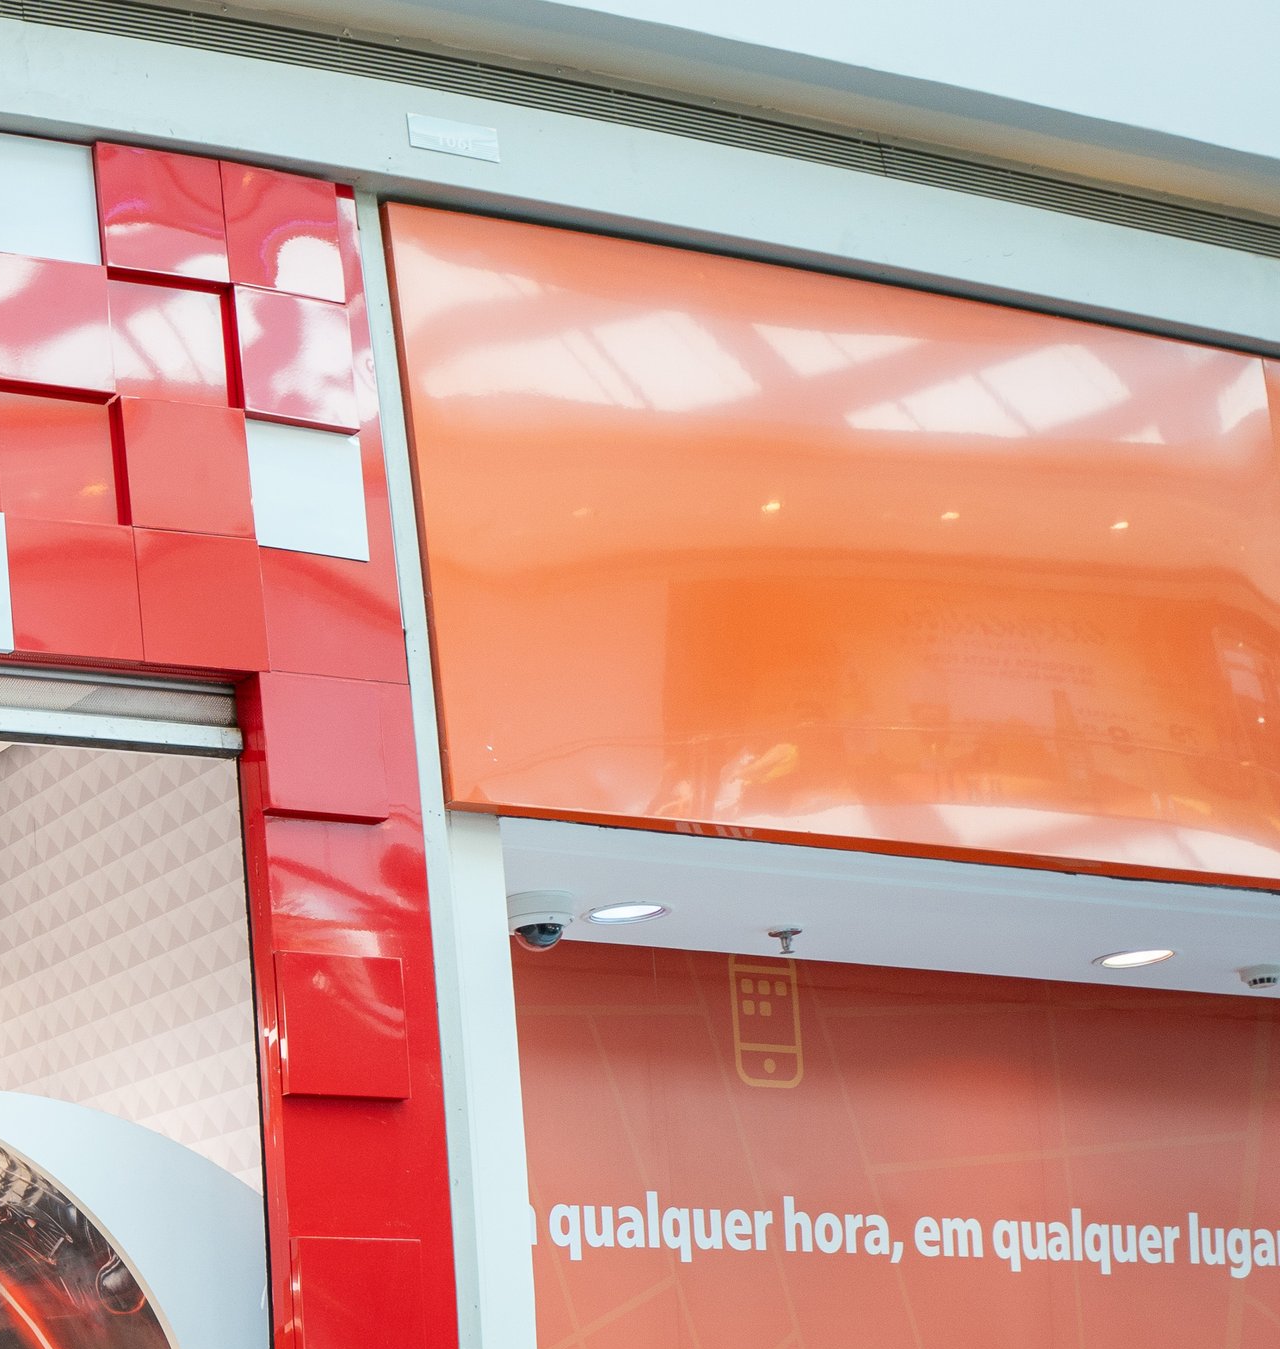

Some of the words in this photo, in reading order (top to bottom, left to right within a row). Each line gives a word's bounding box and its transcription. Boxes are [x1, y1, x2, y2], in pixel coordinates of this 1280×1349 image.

[548, 1190, 774, 1263] qualquer
[783, 1195, 904, 1264] hora,
[914, 1215, 984, 1258] em
[992, 1207, 1181, 1276] qualquer
[1188, 1211, 1280, 1278] luga
